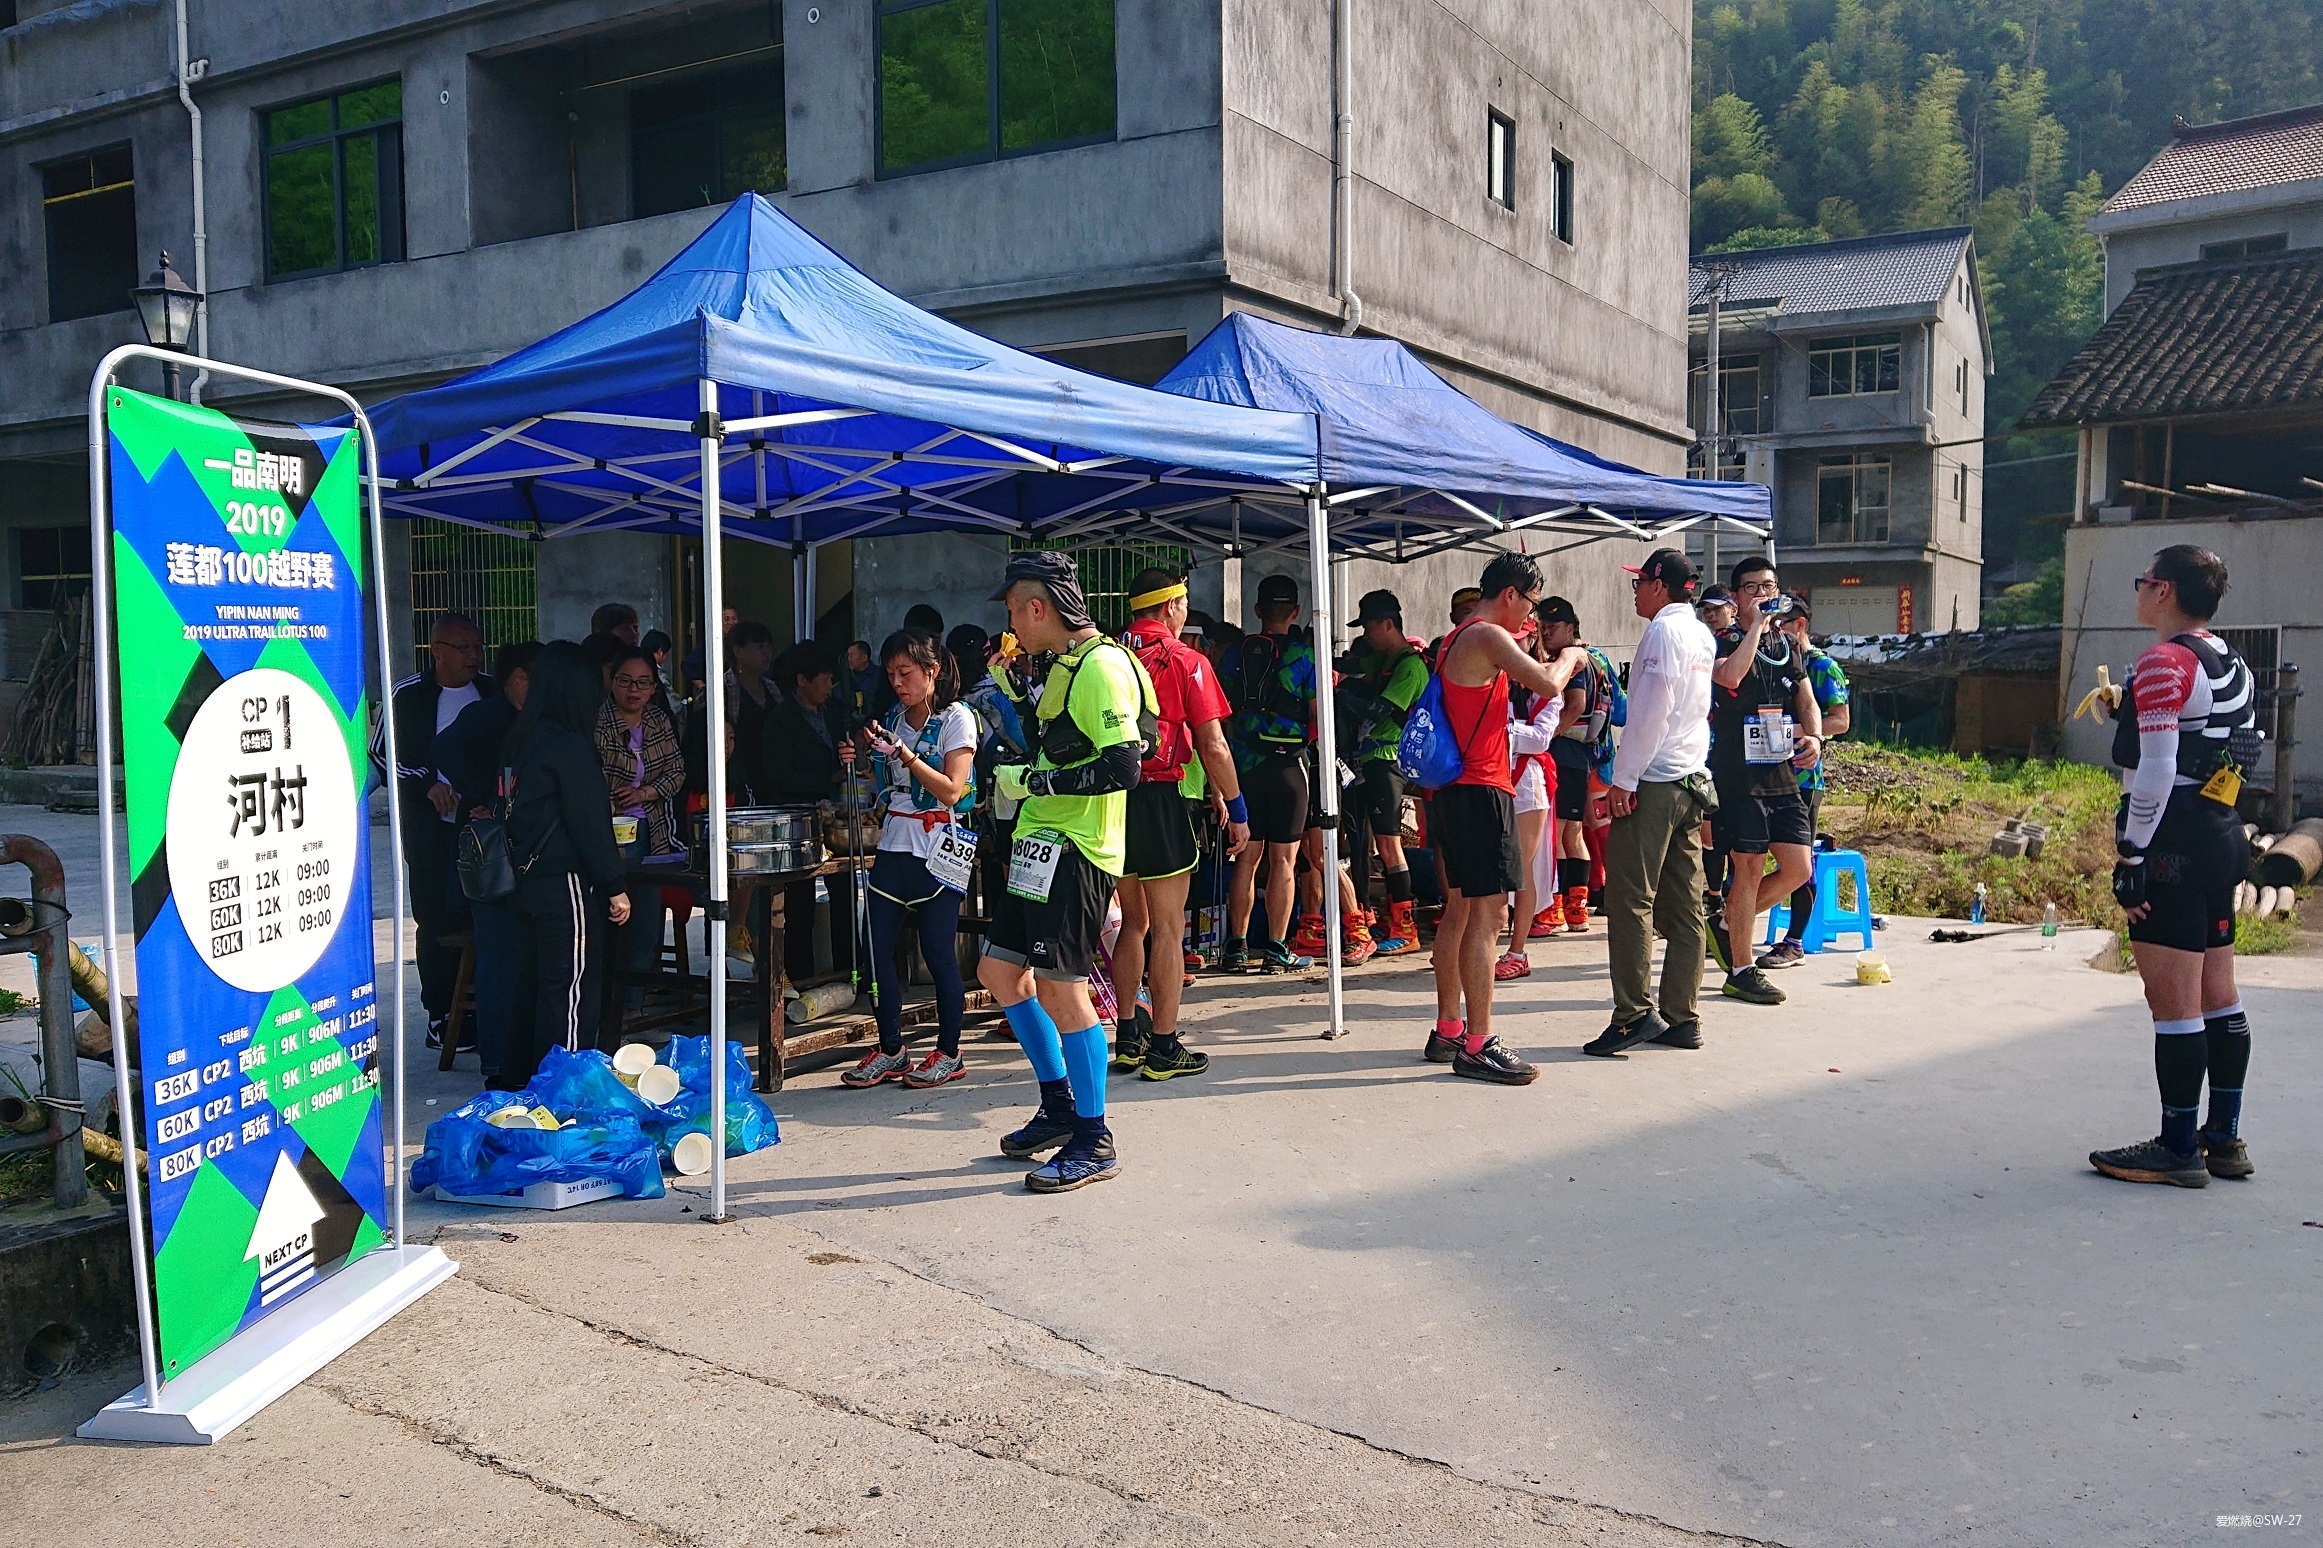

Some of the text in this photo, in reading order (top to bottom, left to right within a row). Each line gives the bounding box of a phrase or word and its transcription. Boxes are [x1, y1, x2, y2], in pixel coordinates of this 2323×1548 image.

[204, 447, 302, 495] 一品南明
[226, 501, 285, 536] 2019
[166, 542, 334, 589] 莲都100越野赛
[183, 624, 327, 640] 2019 ULTRA TRAIL LOTUS 100
[215, 605, 299, 620] YIPIN NAN MING
[241, 695, 292, 749] CP 1
[241, 730, 271, 753] 补给站
[226, 764, 308, 839] 河村
[210, 859, 330, 901] 36K 12K 09:00
[211, 884, 331, 929] 60K 12K 09:00
[212, 909, 332, 956] 80K 12K 09:00
[161, 1003, 376, 1100] 36K CP2 西坑 9K 906M 11:30
[164, 1035, 378, 1137] 60K CP2 西坑 9K 906M 11:30
[165, 1068, 379, 1176] 80K CP2 西坑 9K 906M 11:30
[264, 1233, 308, 1269] NEXT CP
